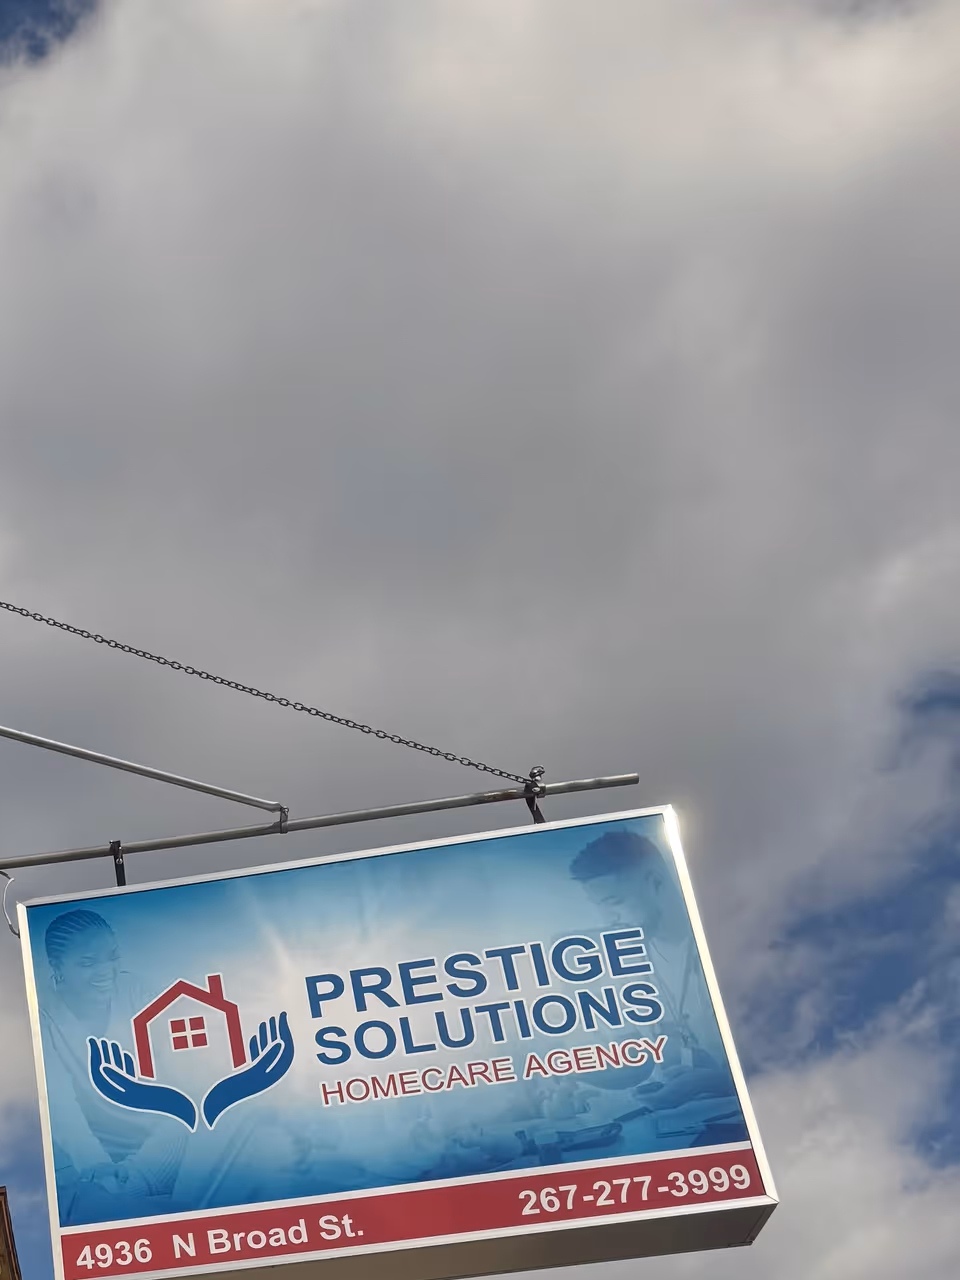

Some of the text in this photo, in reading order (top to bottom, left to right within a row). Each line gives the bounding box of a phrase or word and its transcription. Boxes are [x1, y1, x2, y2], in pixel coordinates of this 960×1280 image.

[304, 928, 653, 1020] PRESTIGE
[314, 983, 664, 1066] SOLUTIONS
[320, 1036, 667, 1106] HOMECARE AGENCY
[518, 1164, 751, 1216] 267-277-3999
[76, 1213, 365, 1270] 4936 N Broad St.
